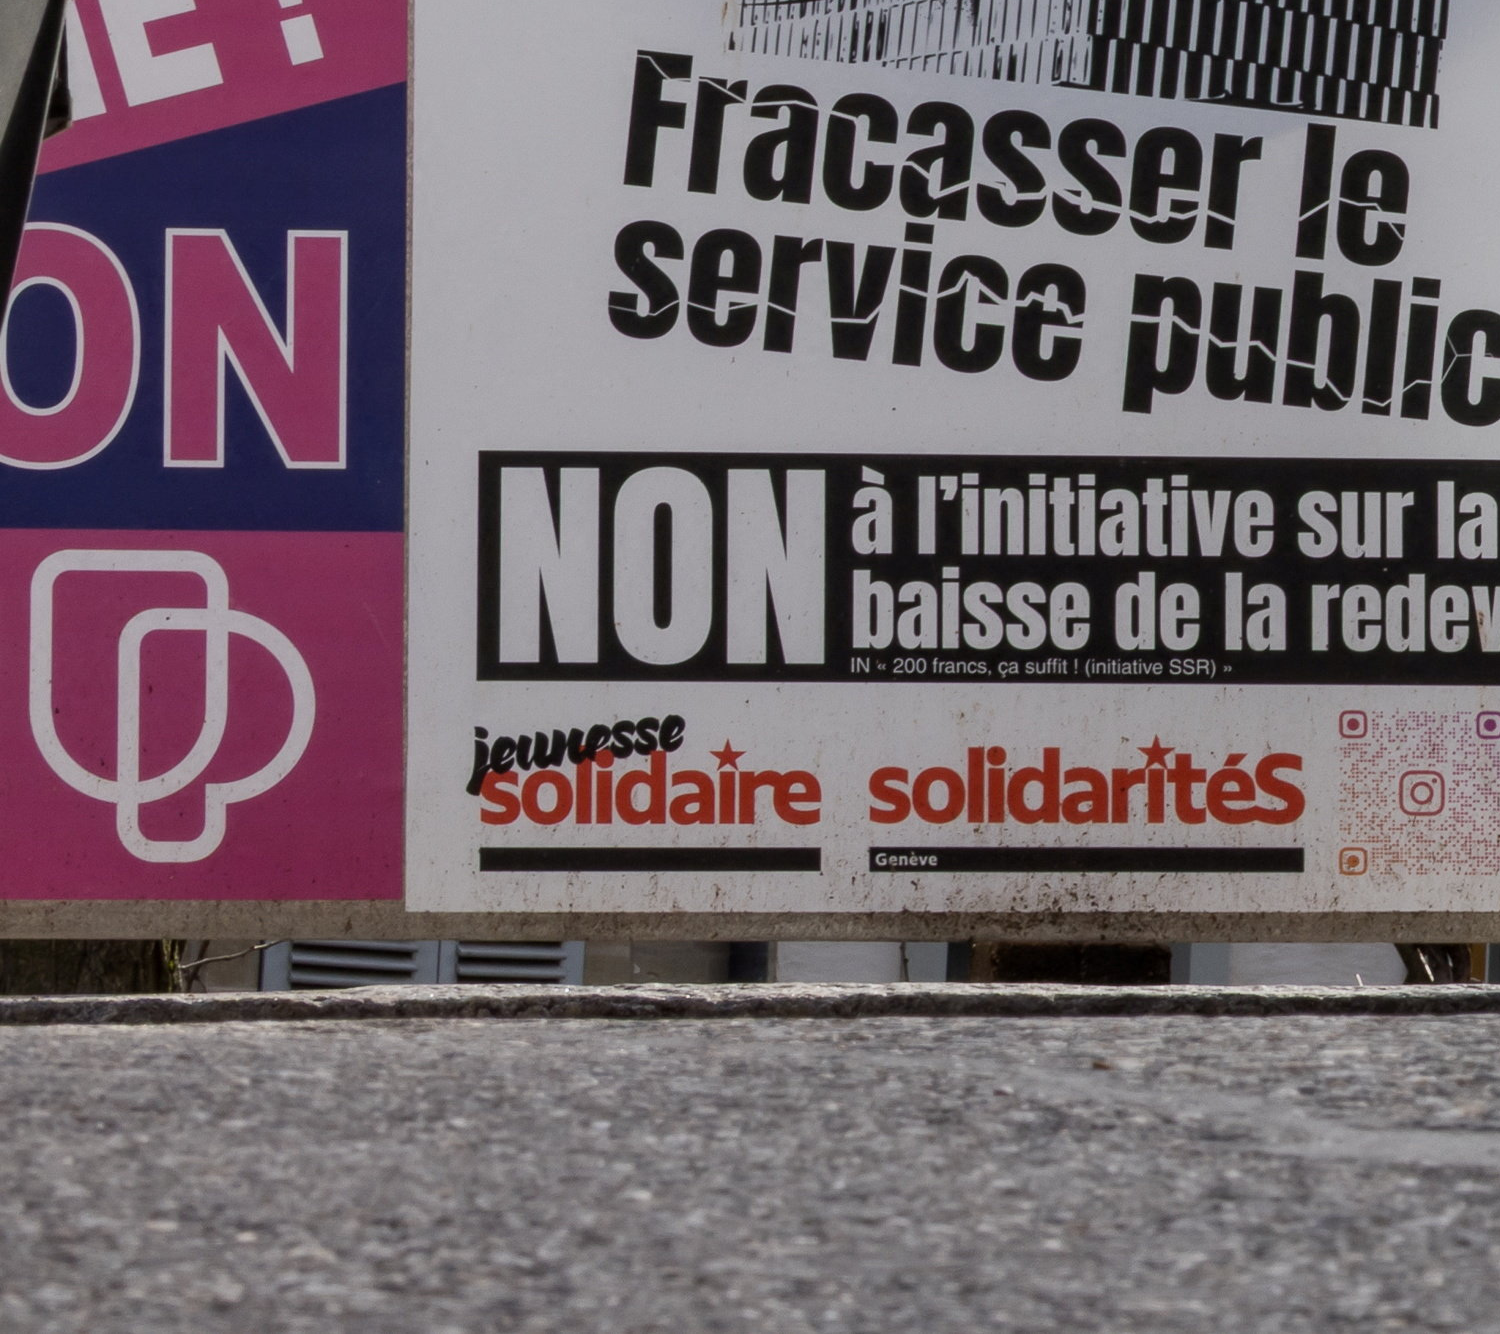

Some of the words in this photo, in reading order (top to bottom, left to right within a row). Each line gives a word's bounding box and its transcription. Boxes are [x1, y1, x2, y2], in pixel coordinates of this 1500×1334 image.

[624, 49, 1262, 251] Fracasser
[1295, 123, 1412, 267] le
[607, 219, 1087, 382] service
[852, 465, 893, 555] à
[917, 473, 1275, 558] l'initiative
[1297, 490, 1415, 559] sur
[1437, 480, 1499, 560] la
[499, 466, 826, 666] NON
[852, 566, 1091, 651] baisse
[1114, 572, 1200, 651] de
[1224, 572, 1287, 651] la
[851, 658, 870, 674] IN
[893, 658, 927, 674] 200
[932, 658, 993, 677] francs,
[997, 661, 1021, 678] ça
[1025, 658, 1068, 674] suffit
[1084, 658, 1163, 678] (initiative
[1169, 659, 1217, 679] SSR)
[466, 714, 686, 796] jeunesse
[479, 742, 822, 826] solidaire
[875, 851, 938, 868] Genève
